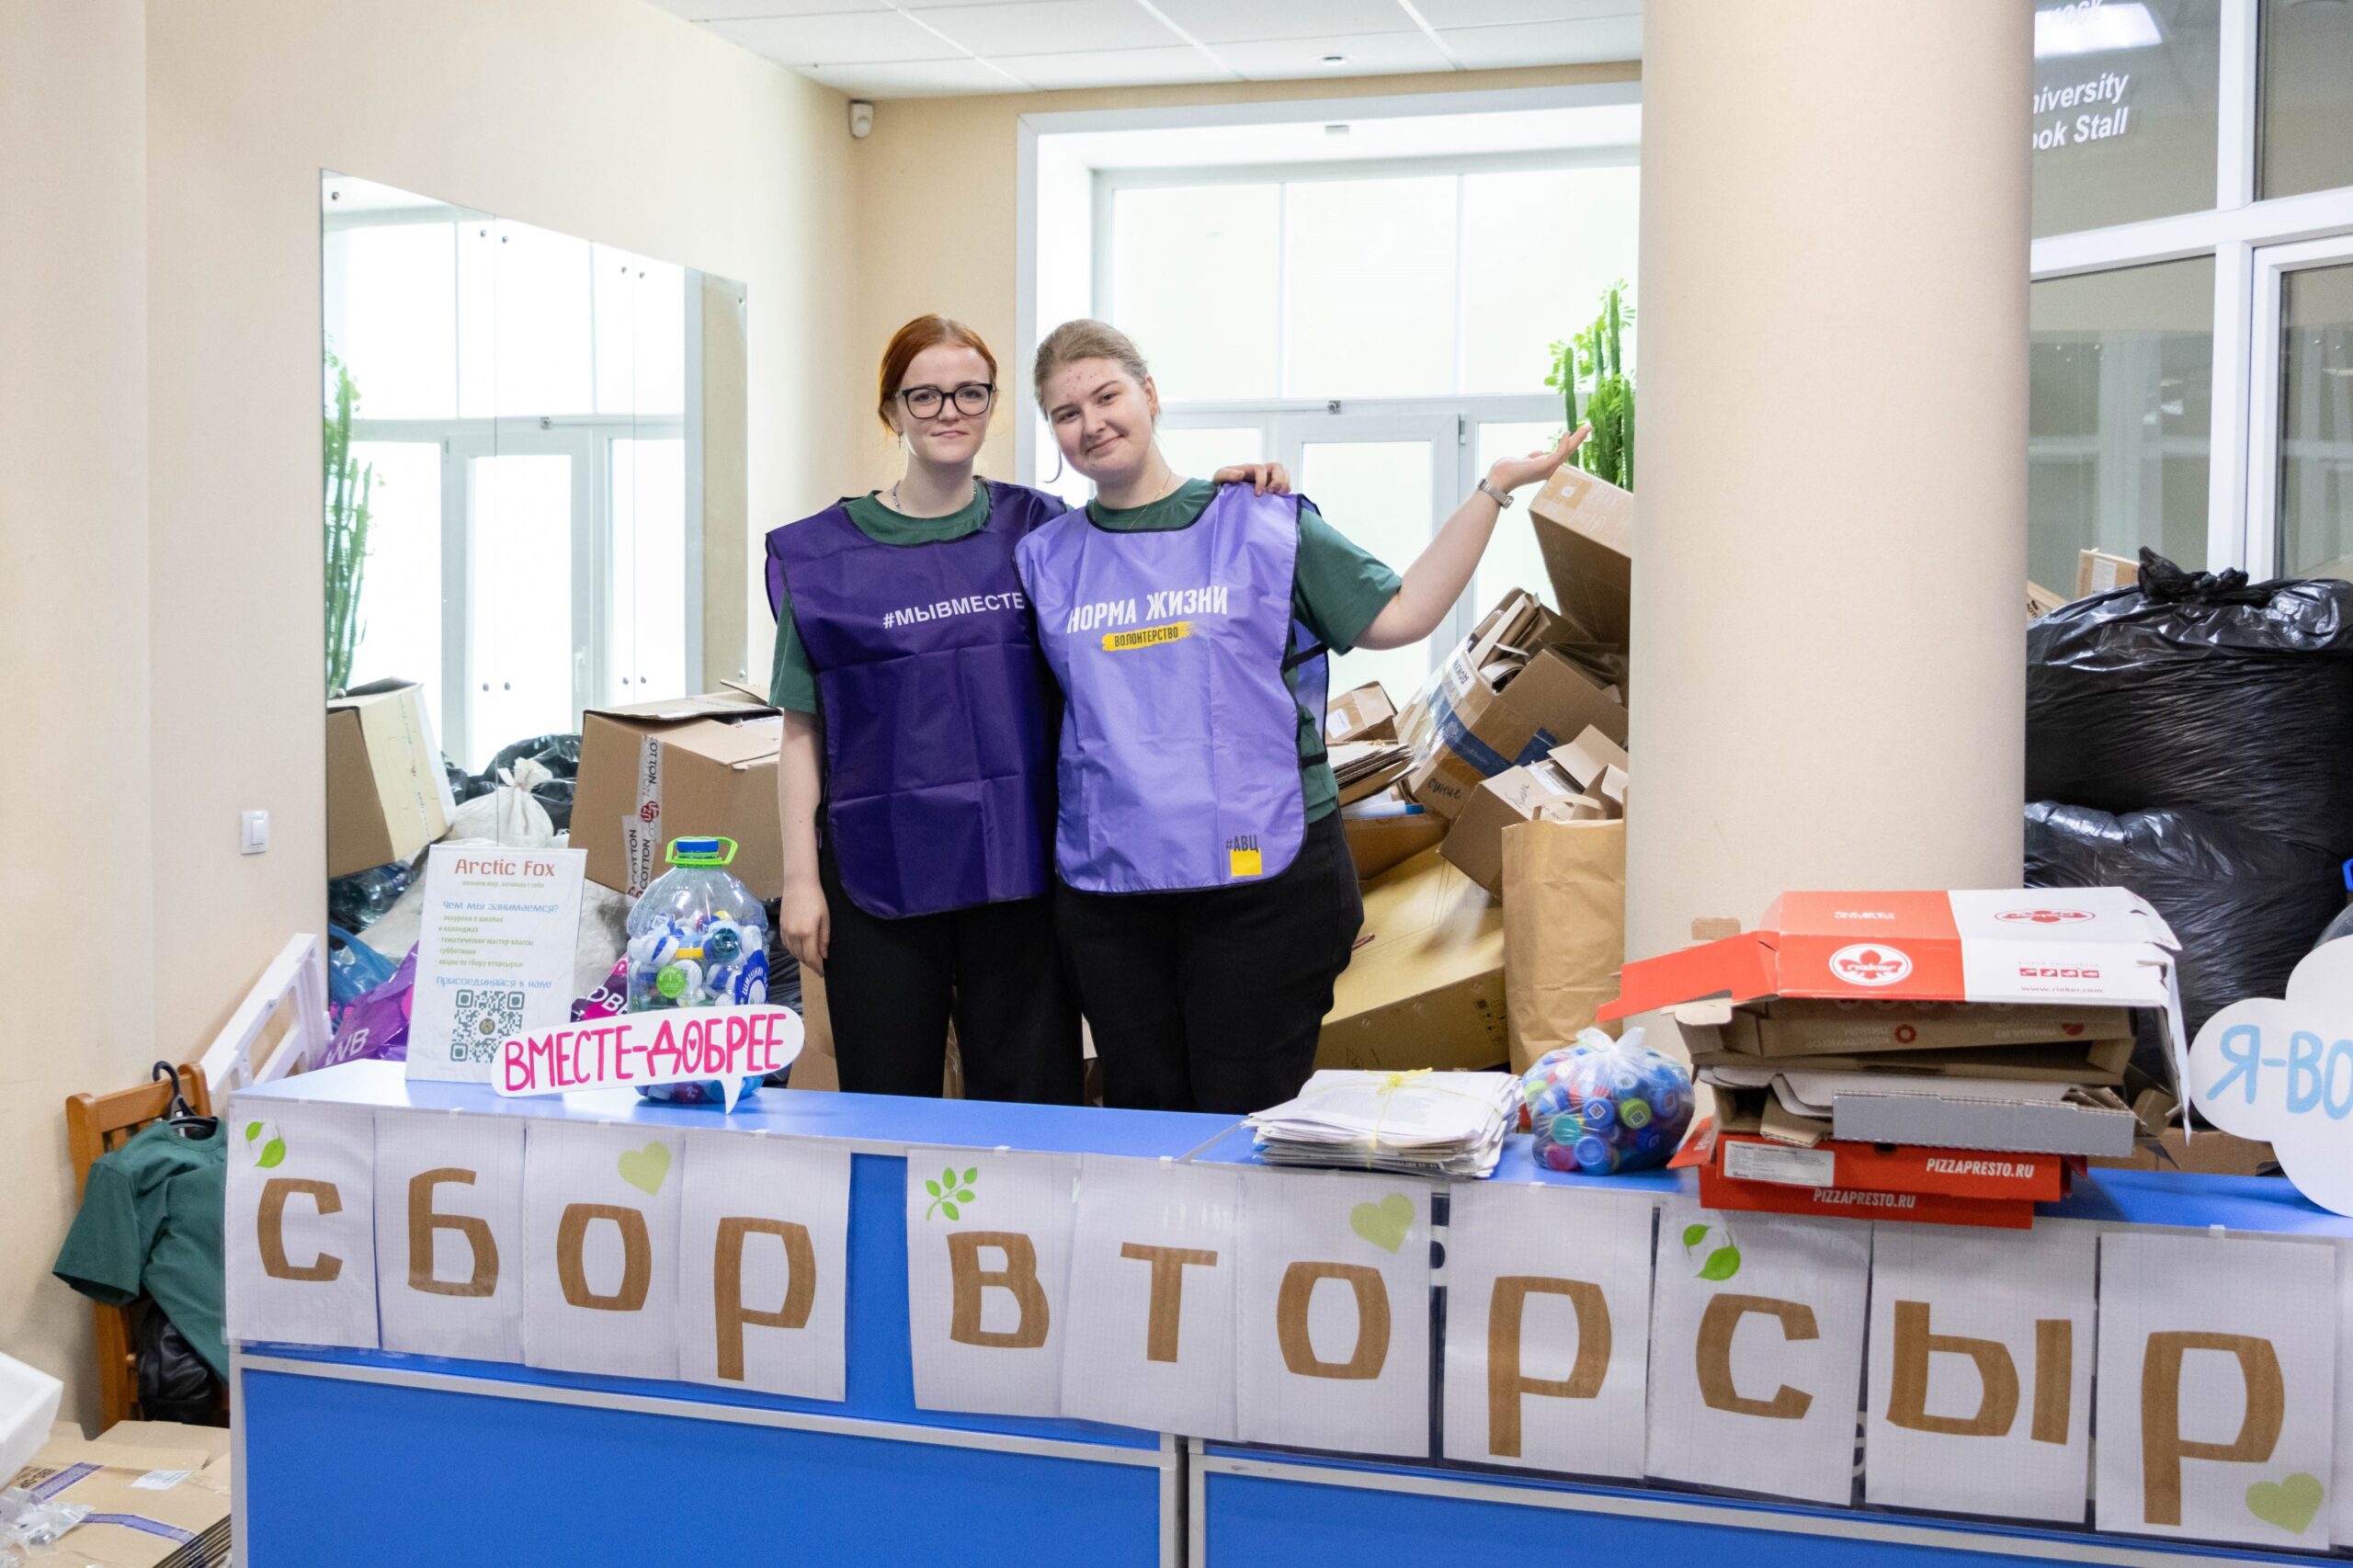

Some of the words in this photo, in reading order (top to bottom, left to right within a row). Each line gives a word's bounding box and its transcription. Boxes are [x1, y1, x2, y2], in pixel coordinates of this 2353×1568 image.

[2073, 107, 2130, 143] Stall
[882, 591, 1026, 630] #МЫВМЕСТЕ
[1066, 597, 1137, 634] НОРМА
[1145, 585, 1229, 622] ЖИЗНИ
[1113, 626, 1179, 648] ВОЛОНТЕРСТВО
[1225, 834, 1259, 854] #АВЦ
[454, 858, 517, 876] Arctic
[523, 860, 555, 877] Fox
[639, 838, 651, 891] COTTON
[443, 900, 463, 910] Чем
[467, 902, 485, 911] мы
[488, 903, 560, 914] занимаемся?
[441, 937, 485, 945] тематические
[436, 975, 517, 988] Присоединяйся
[528, 981, 552, 989] нам!
[505, 1013, 788, 1092] ВМЕСТЕ-ДОБРЕЕ
[1926, 1158, 2034, 1178] PIZZAPRESTO.RU
[1813, 1188, 1916, 1209] PIZZAPRESTO.RU
